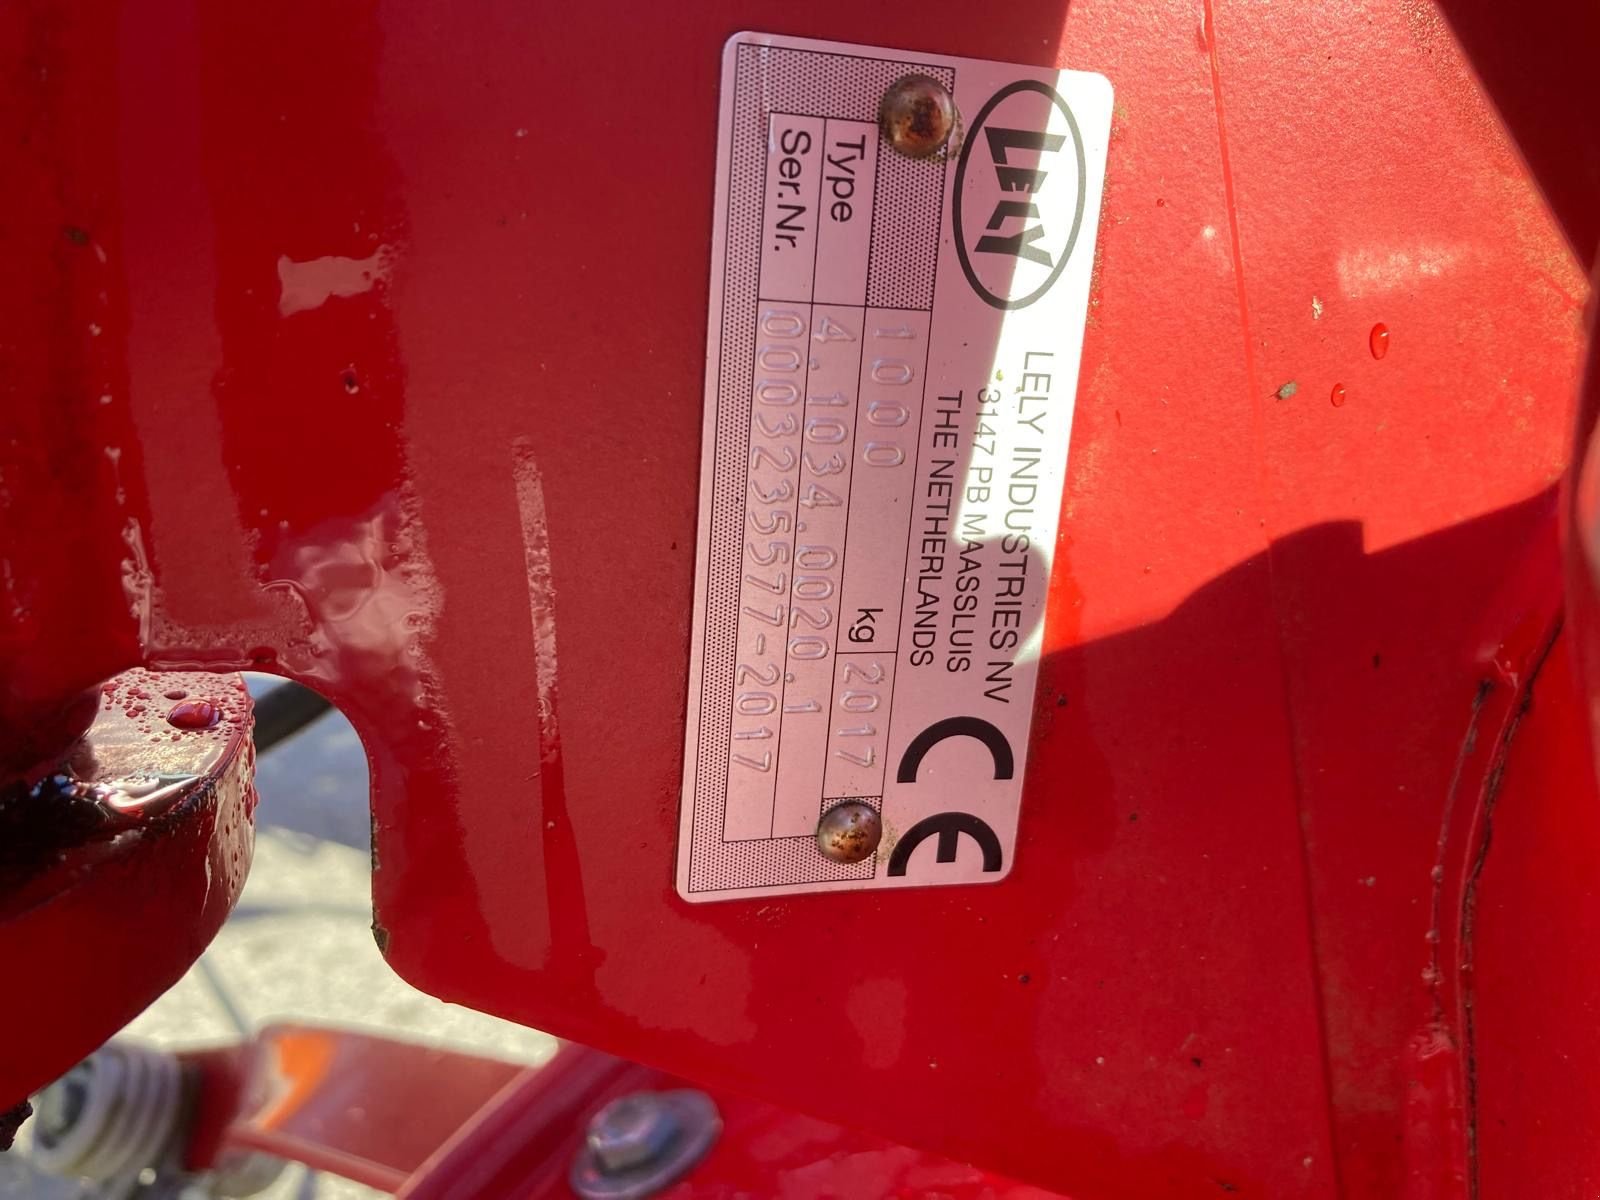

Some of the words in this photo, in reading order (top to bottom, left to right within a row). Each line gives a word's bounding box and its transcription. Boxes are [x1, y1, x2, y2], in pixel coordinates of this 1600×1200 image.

[774, 129, 812, 252] Ser.Nr.
[825, 134, 866, 223] Type
[974, 126, 1067, 268] LELY
[864, 325, 915, 468] 1000
[933, 390, 963, 448] THE
[972, 388, 1001, 456] 3147
[1017, 351, 1054, 434] LELY
[732, 309, 805, 772] 0003235577-2017
[783, 316, 856, 714] 4.1034.0020.1
[966, 466, 993, 504] PB
[910, 459, 955, 667] NETHERLANDS
[947, 513, 986, 673] MAASSLUIS
[989, 447, 1042, 650] INDUSTRIES
[848, 608, 883, 644] kg
[983, 660, 1015, 704] NV
[835, 661, 885, 768] 2017
[887, 716, 1014, 876] CE
